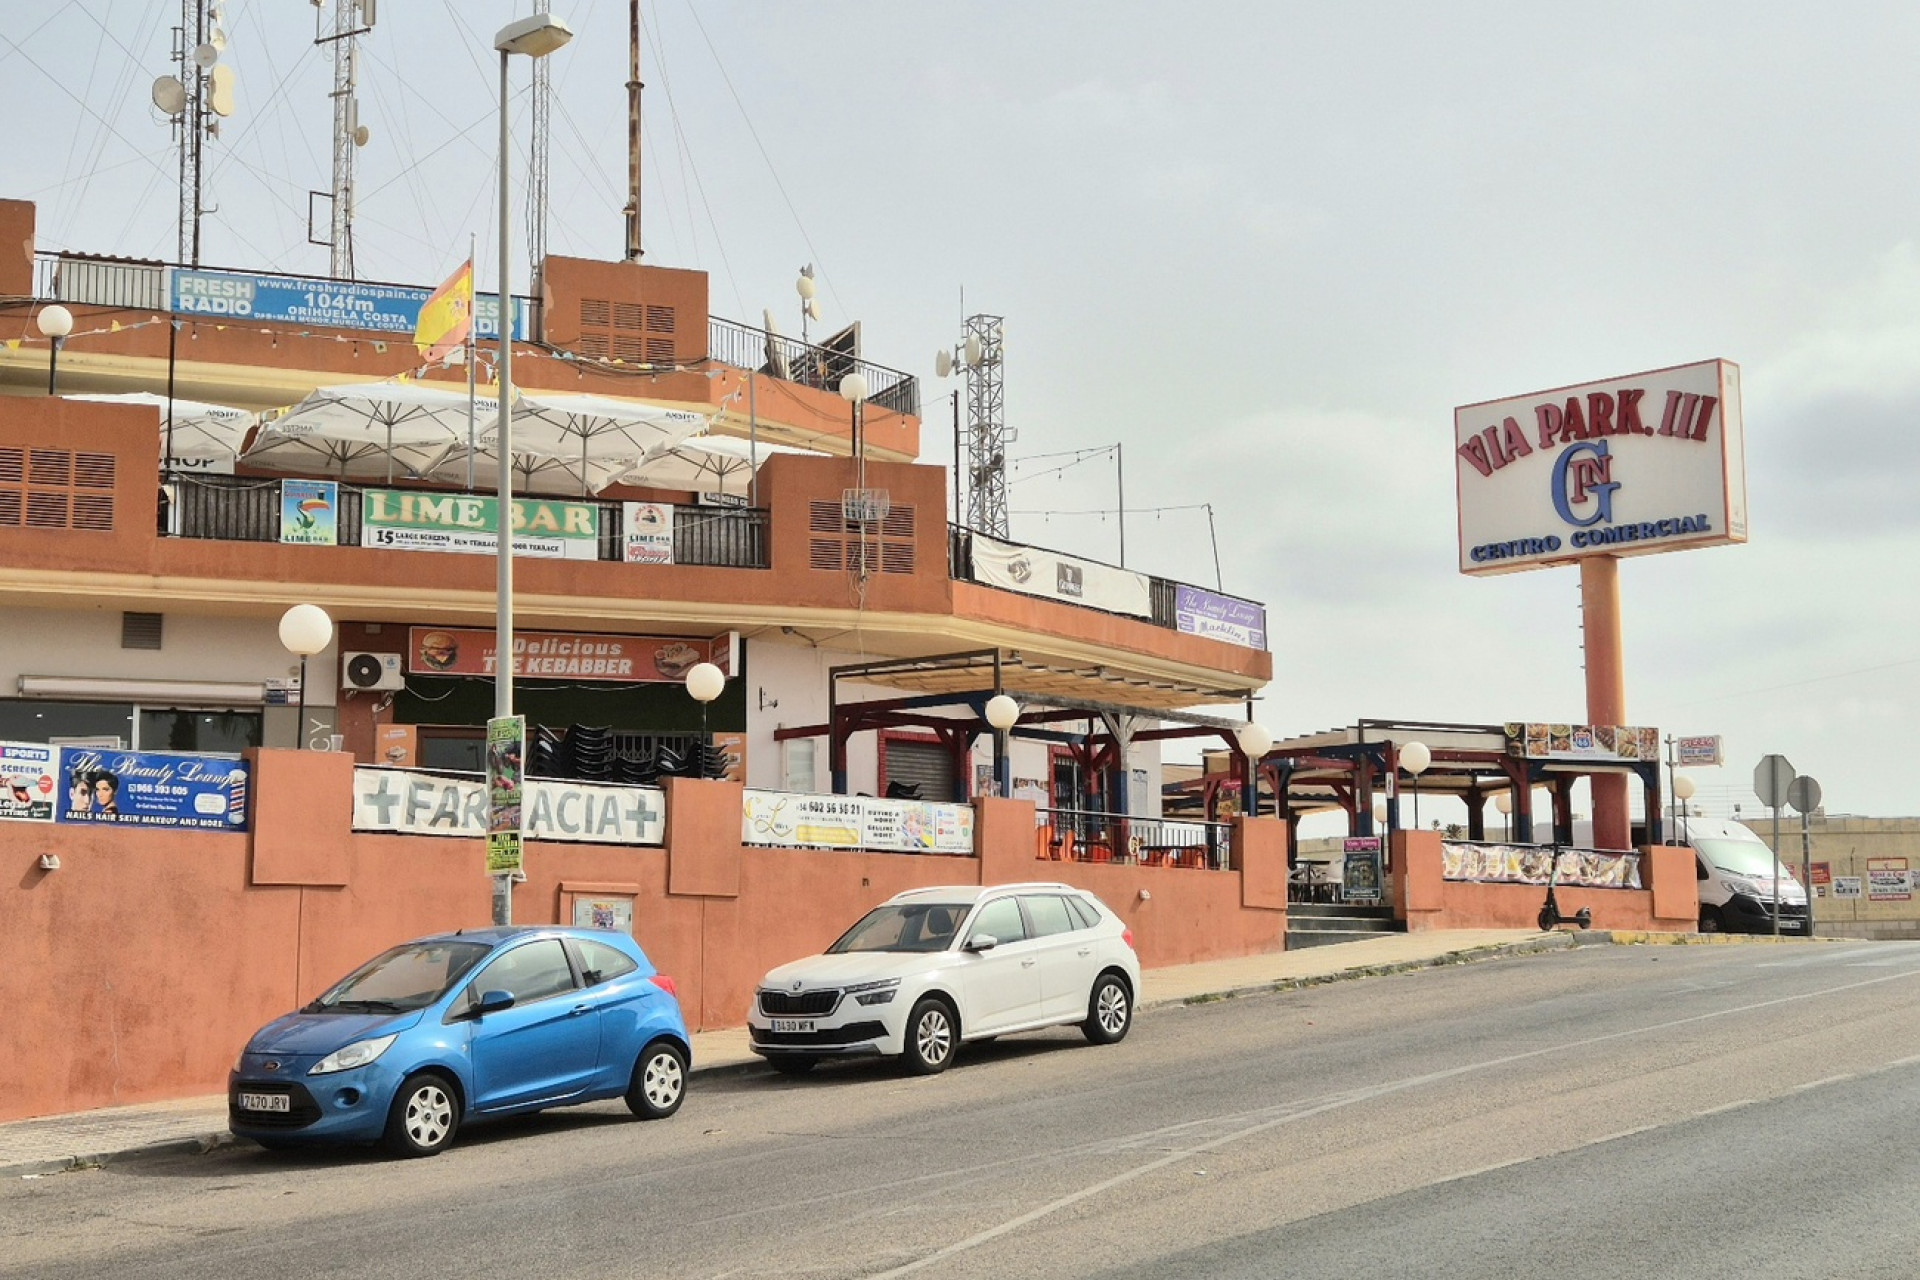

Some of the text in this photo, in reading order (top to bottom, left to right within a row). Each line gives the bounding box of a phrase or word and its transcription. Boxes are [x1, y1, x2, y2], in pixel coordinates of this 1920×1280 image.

[179, 276, 251, 298] FRESH
[179, 294, 251, 315] RADIO
[304, 291, 374, 312] 104fm
[288, 306, 407, 324] ORIHUELA COSTA
[1457, 416, 1533, 477] VIA
[1656, 390, 1718, 442] III
[369, 493, 486, 527] LIME
[377, 530, 395, 544] 15
[1470, 514, 1711, 562] CENTRO COMERCIAL
[511, 638, 622, 655] Delicious
[483, 655, 632, 675] TE KEBABBER
[5, 749, 48, 760] SPORTS
[1, 764, 44, 775] SCREENS
[65, 752, 103, 772] The
[110, 755, 175, 785] Beauty
[405, 780, 622, 836] FARACIA
[65, 811, 93, 820] NAILS
[95, 813, 117, 822] HAIR
[118, 814, 140, 823] SKIN
[141, 815, 177, 825] MAKEUP
[179, 818, 197, 826] AND
[244, 1096, 267, 1109] 7470
